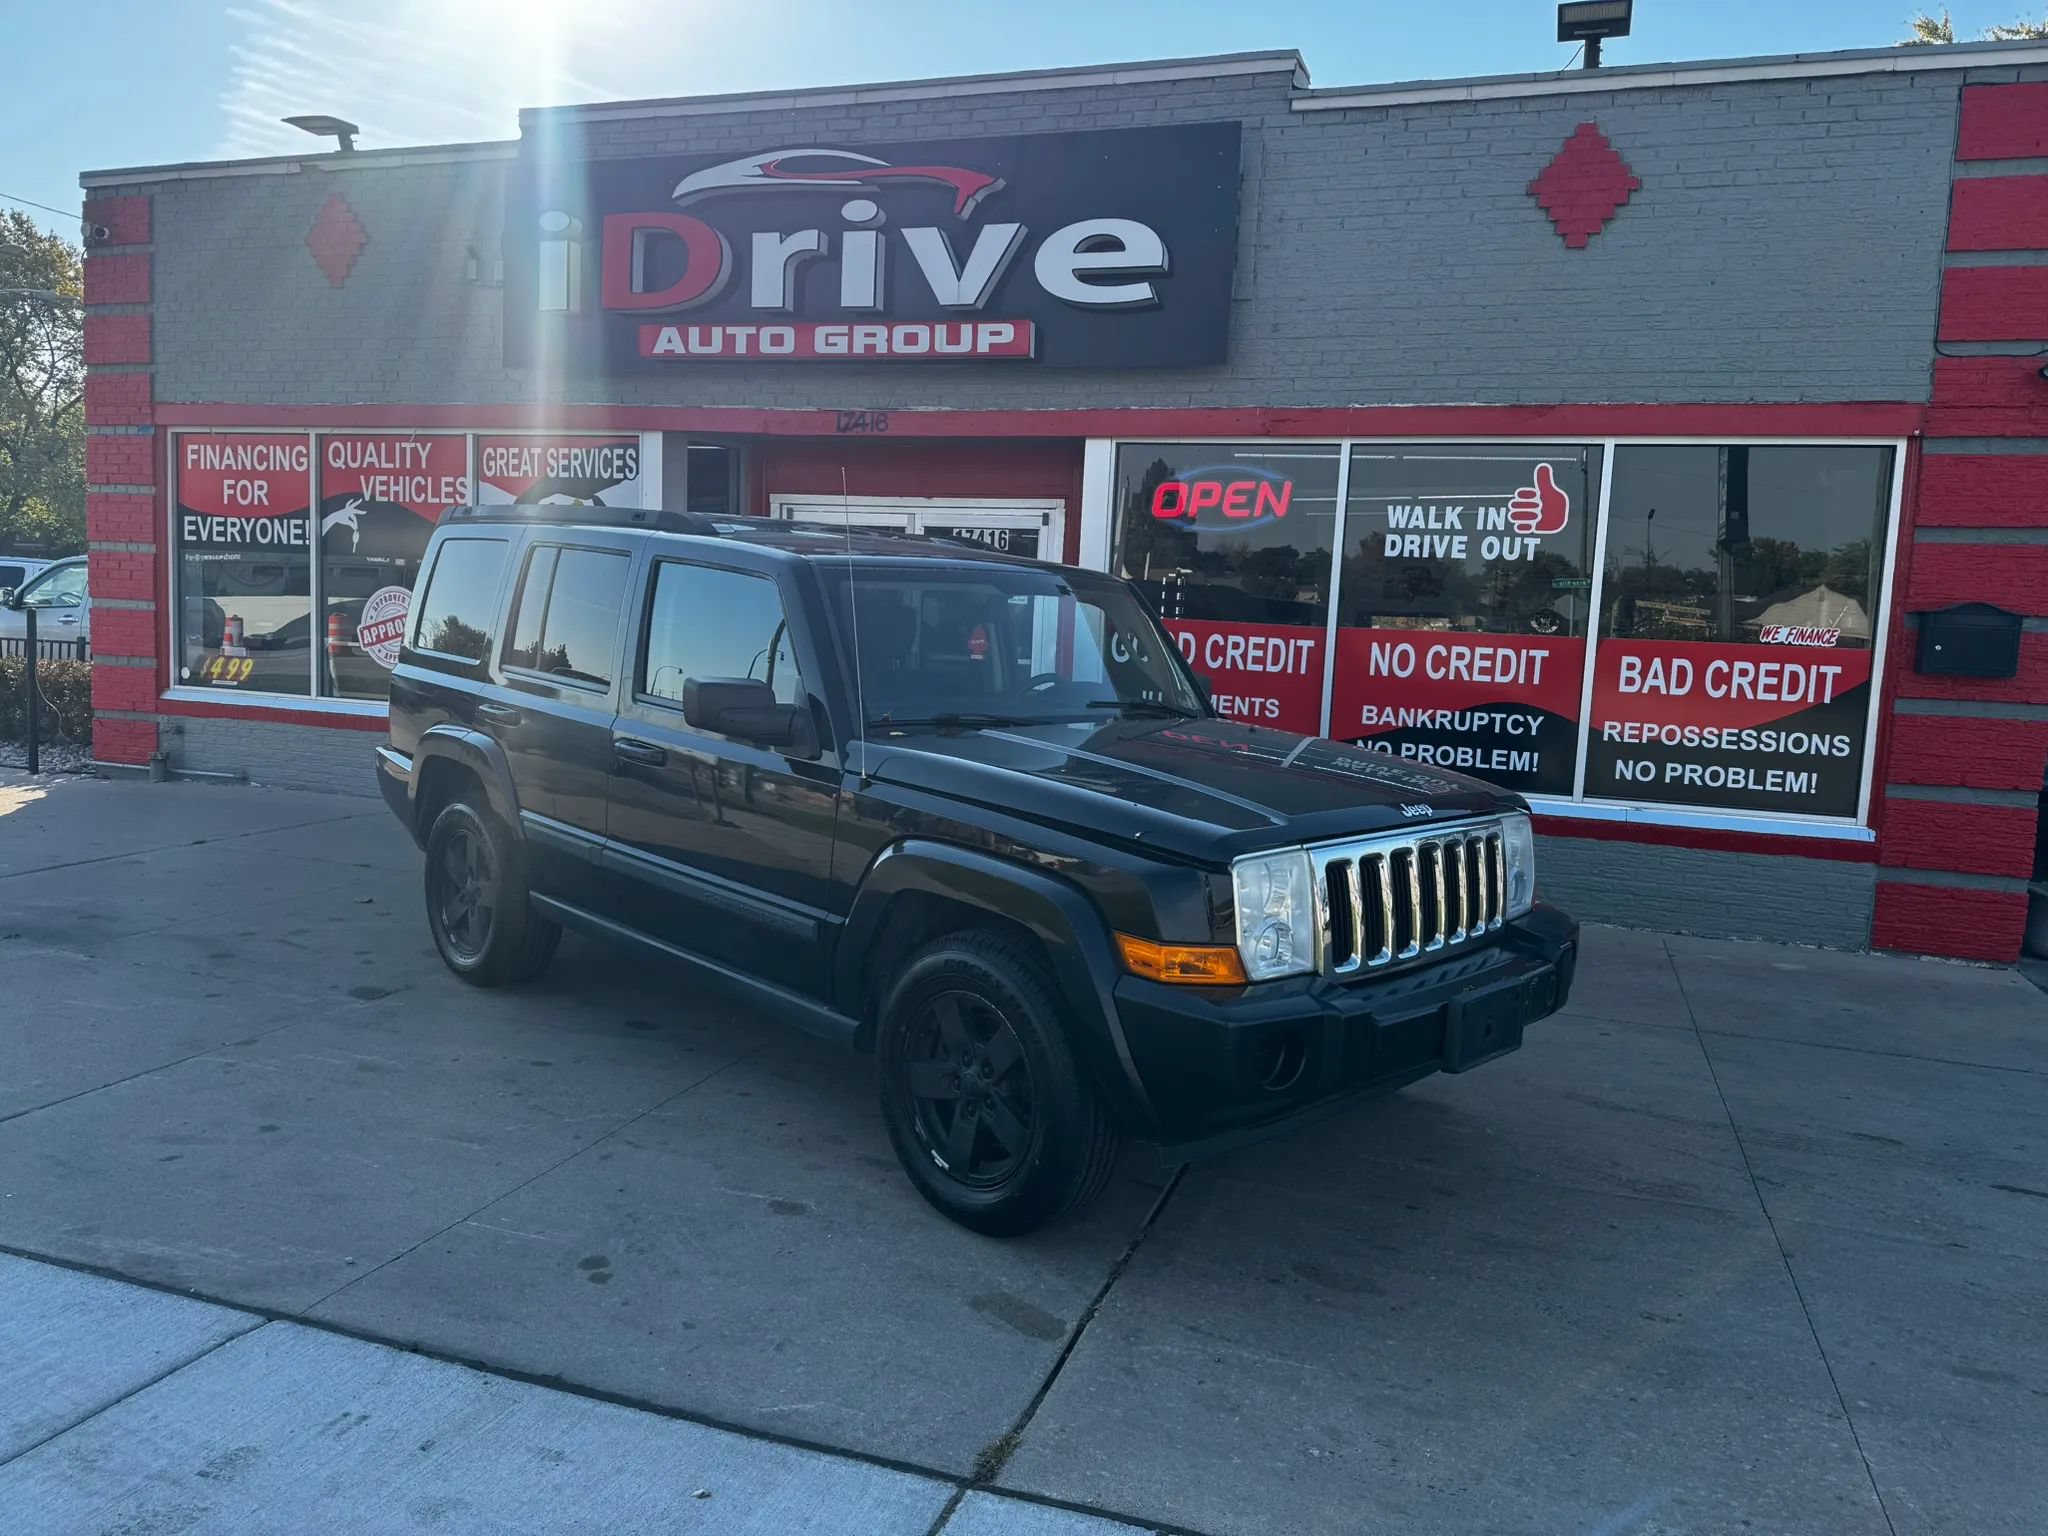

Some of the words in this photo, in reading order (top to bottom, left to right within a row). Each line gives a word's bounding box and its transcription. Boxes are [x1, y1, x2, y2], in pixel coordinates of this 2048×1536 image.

[538, 200, 1168, 313] iDrive
[652, 325, 796, 354] AUTO
[814, 323, 1015, 354] GROUP
[837, 411, 888, 432] 17416
[186, 444, 308, 471] FINANCING
[328, 441, 432, 470] QUALITY
[483, 447, 541, 477] GREAT
[546, 448, 637, 480] SERVICES
[223, 479, 269, 505] FOR
[360, 475, 467, 505] VEHICLES
[1152, 481, 1292, 517] OPEN
[183, 516, 309, 545] EVERYONE!
[1387, 505, 1464, 530] WALK
[1476, 506, 1507, 531] IN
[1384, 534, 1468, 559] DRIVE
[1480, 536, 1541, 561] OUT
[362, 618, 406, 645] APPRO
[1761, 625, 1783, 642] WE
[1785, 627, 1840, 646] FINANCE
[1204, 634, 1315, 675] CREDIT
[1369, 642, 1416, 678] NO
[1425, 644, 1550, 685] CREDIT
[1618, 655, 1694, 695] BAD
[1705, 659, 1842, 704] CREDIT
[1361, 705, 1545, 736] BANKRUPTCY
[1602, 721, 1851, 757] REPOSSESSIONS
[1401, 743, 1539, 772] PROBLEM!
[1615, 759, 1656, 782] NO
[1664, 763, 1818, 794] PROBLEM!
[1399, 803, 1433, 818] Jeep
